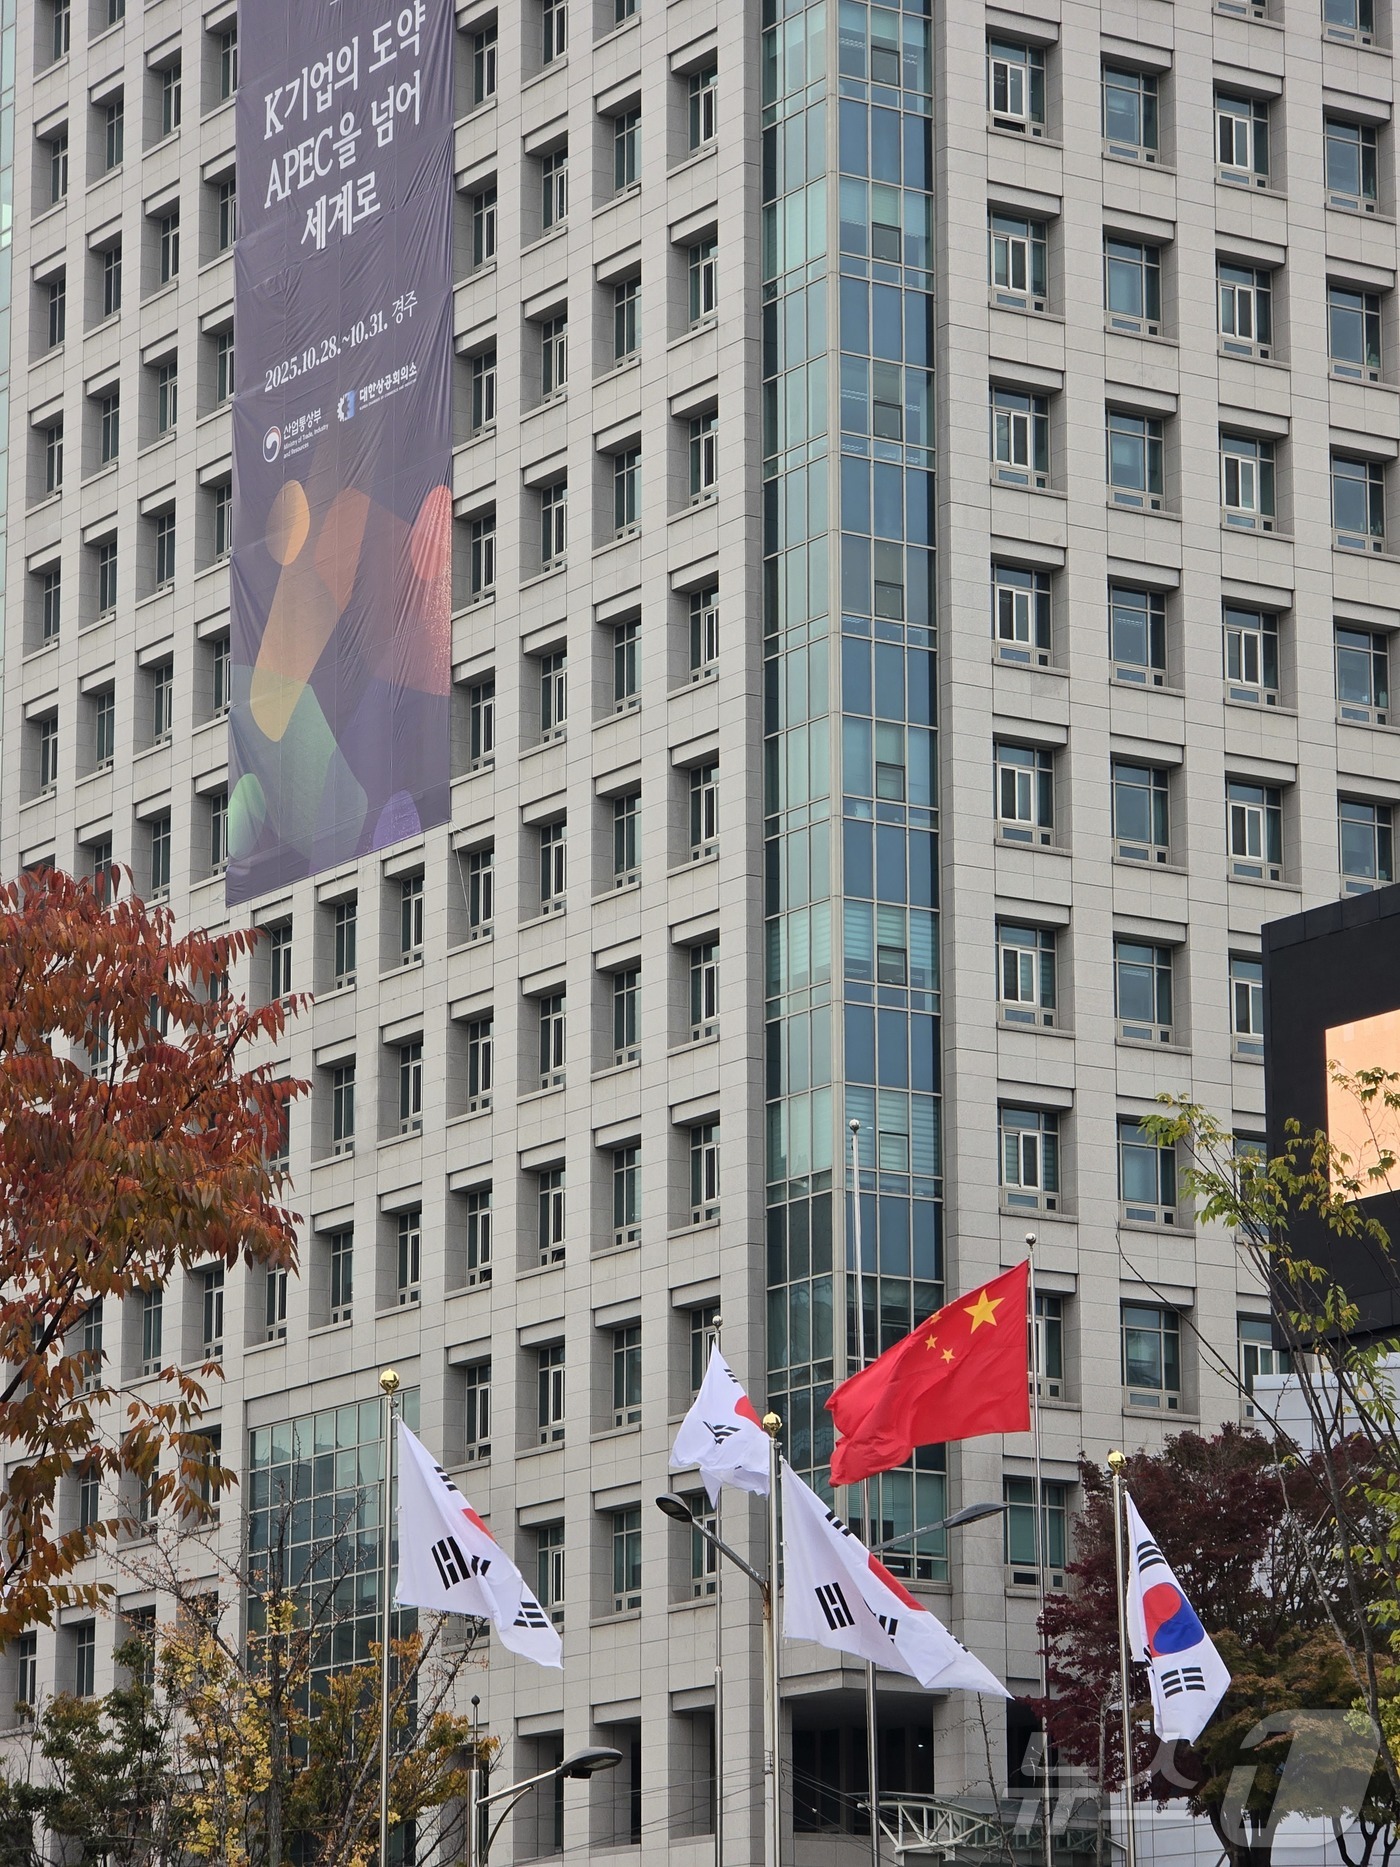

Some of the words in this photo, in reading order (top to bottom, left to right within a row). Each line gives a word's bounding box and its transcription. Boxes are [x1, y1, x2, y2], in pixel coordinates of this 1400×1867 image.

[264, 36, 358, 140] K기업의
[369, 0, 426, 73] 도약
[264, 111, 361, 209] APEC을
[371, 69, 420, 148] 넘어
[301, 171, 380, 250] 세계로
[391, 290, 418, 324] 경주
[359, 361, 417, 403] 대한상공회의소
[283, 407, 322, 440] 산업통상부
